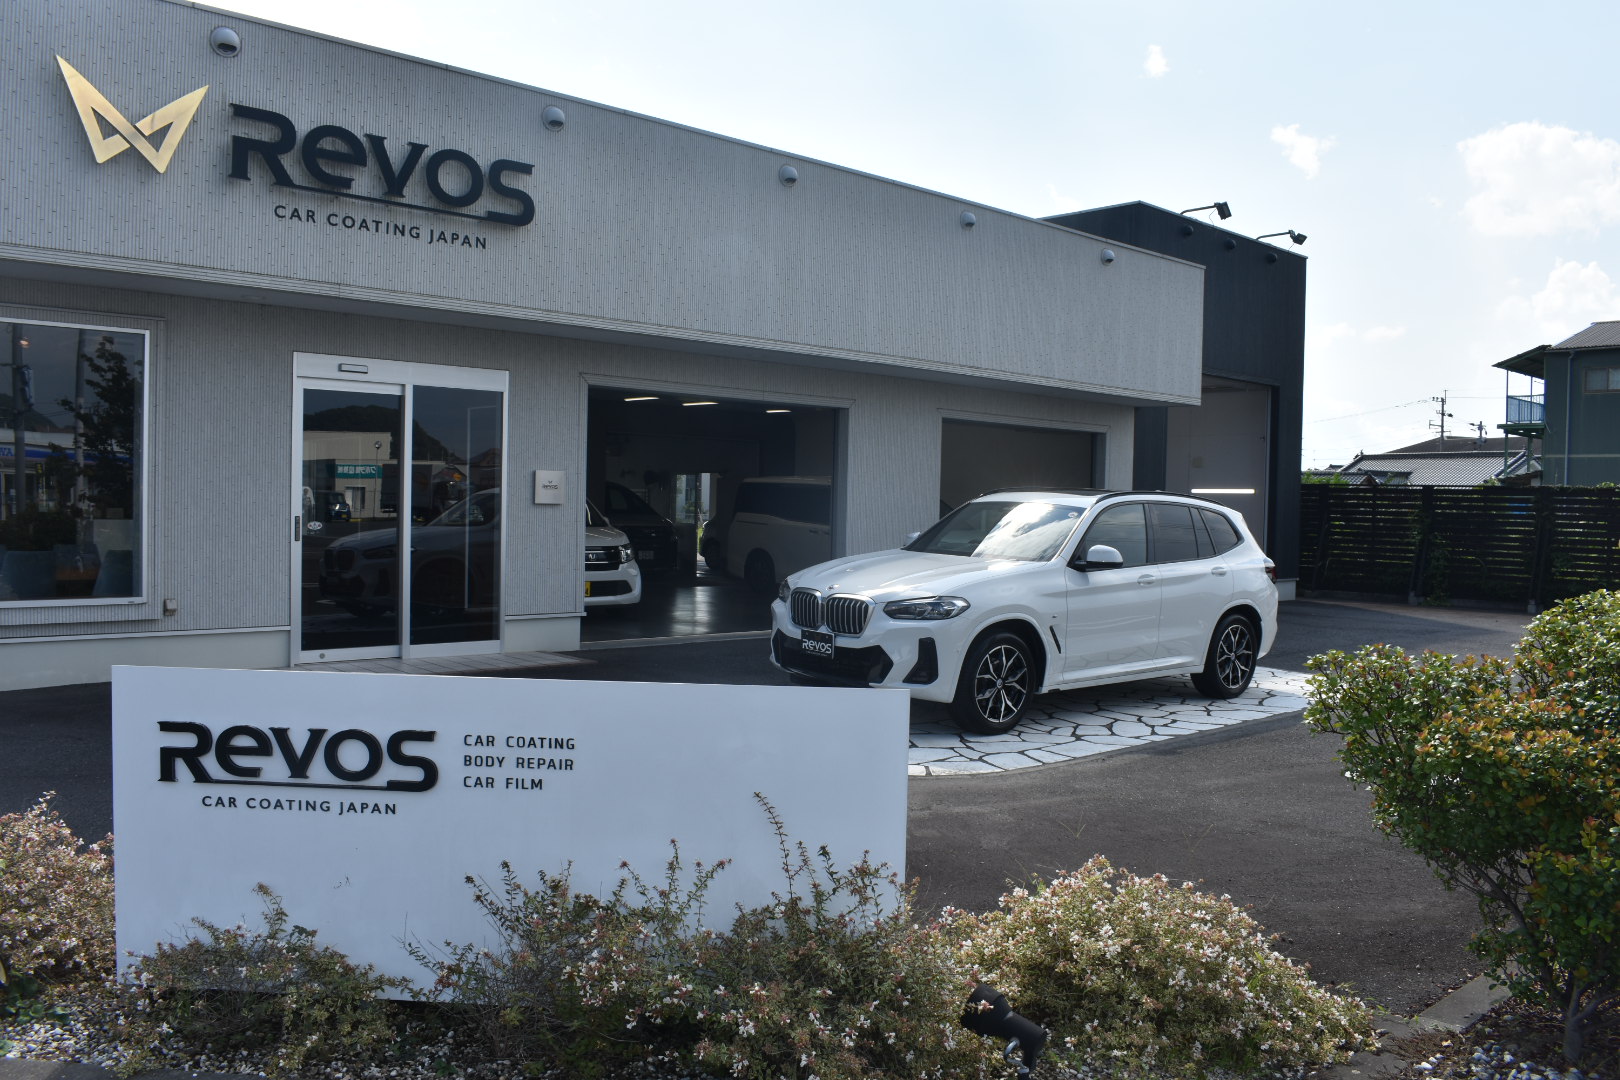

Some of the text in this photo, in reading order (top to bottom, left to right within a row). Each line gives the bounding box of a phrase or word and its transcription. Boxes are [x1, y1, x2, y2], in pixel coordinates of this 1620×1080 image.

[273, 204, 487, 250] CAR COATING JAPAN
[464, 734, 576, 750] CAR COATING
[463, 754, 575, 771] BODY REPAIR
[463, 775, 543, 790] CAR FILM
[201, 795, 397, 816] CAR COATING JAPAN
